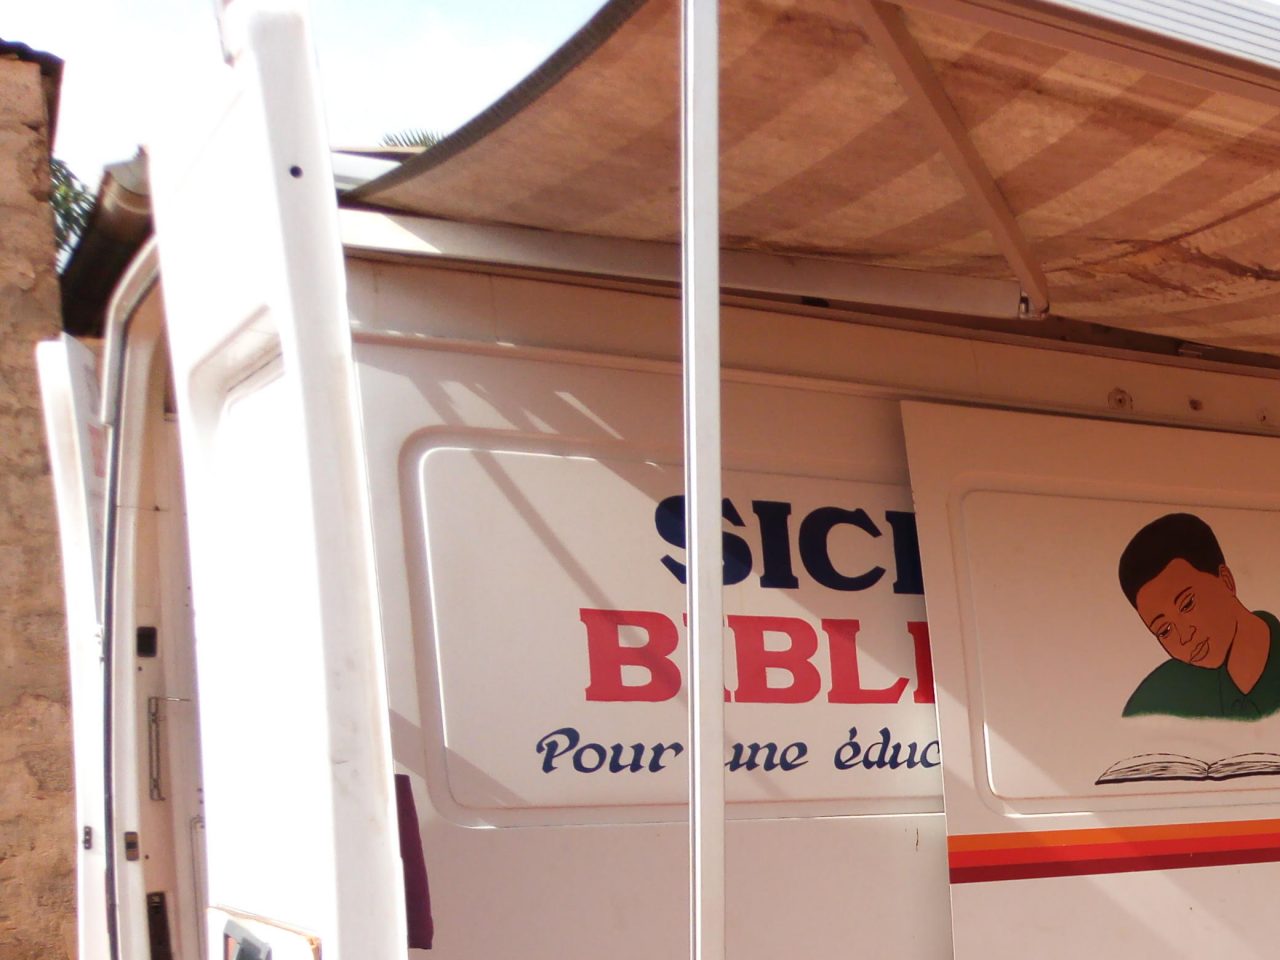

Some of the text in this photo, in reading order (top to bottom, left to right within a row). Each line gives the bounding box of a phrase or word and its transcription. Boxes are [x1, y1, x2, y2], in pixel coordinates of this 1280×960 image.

[580, 608, 935, 704] BBLI
[536, 726, 941, 773] Pour une éduc
